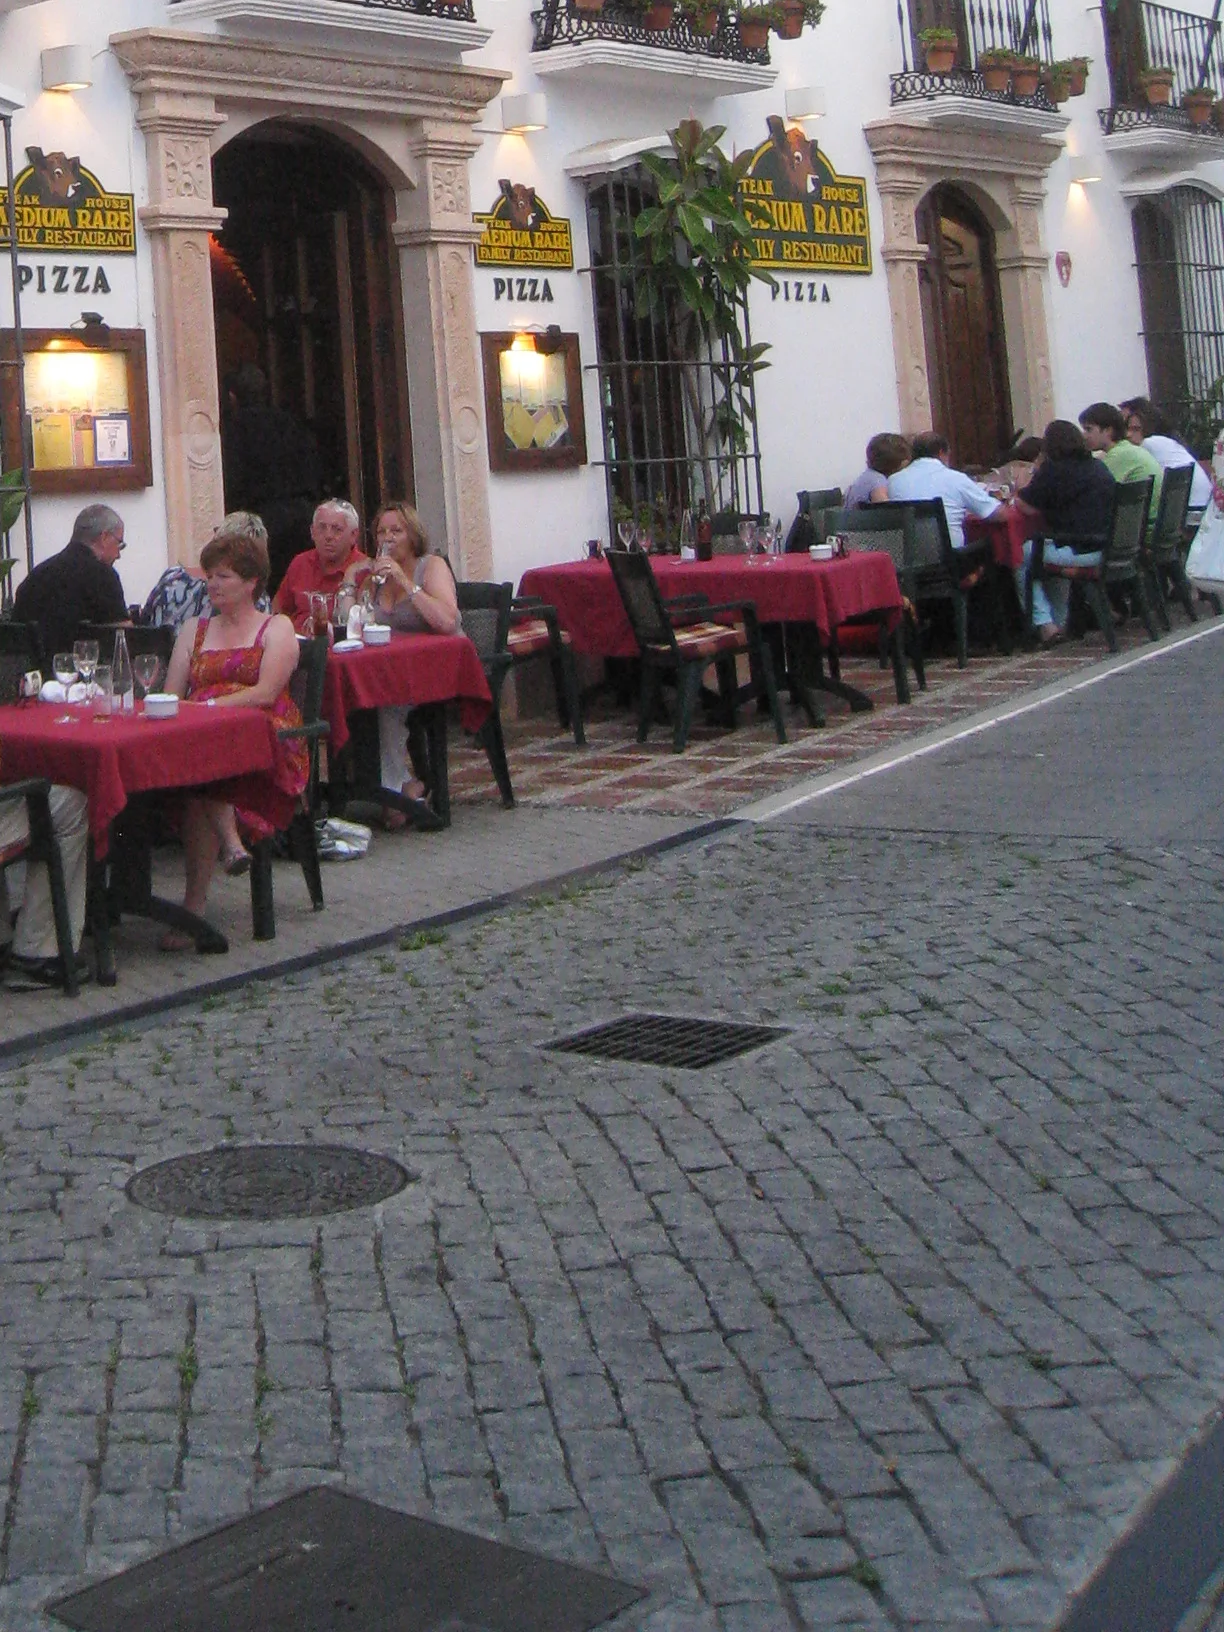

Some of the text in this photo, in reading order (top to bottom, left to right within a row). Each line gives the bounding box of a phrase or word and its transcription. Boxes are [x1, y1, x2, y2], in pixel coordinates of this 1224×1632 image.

[736, 178, 859, 203] TEAK HOUSE
[85, 197, 128, 209] HOUSE
[76, 209, 132, 231] RARE
[539, 222, 567, 232] HOUSE
[729, 197, 866, 236] IUM RARE
[44, 230, 133, 247] RESTAURANT
[480, 230, 570, 250] MEDIUM RARE
[480, 248, 571, 263] FAMILY RESTAURANT
[733, 238, 864, 264] ILY RESTAURANT
[16, 264, 112, 294] PIZZA
[493, 277, 554, 302] PIZZA
[771, 280, 830, 302] PIZZA
